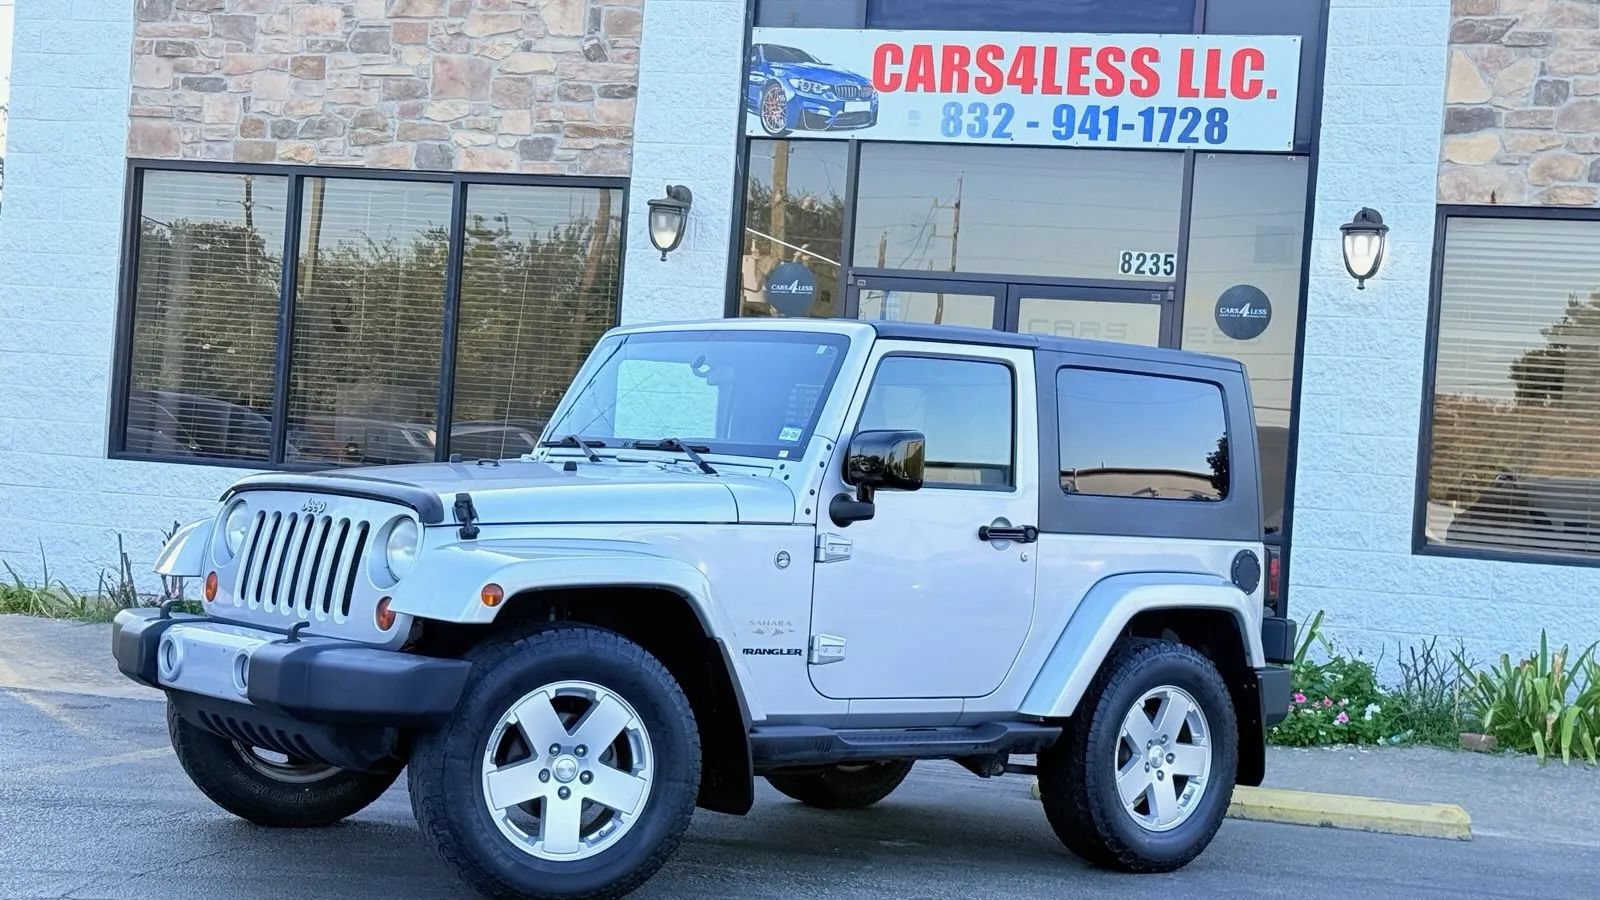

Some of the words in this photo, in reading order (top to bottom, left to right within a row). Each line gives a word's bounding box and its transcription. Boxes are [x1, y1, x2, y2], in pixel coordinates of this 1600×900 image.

[872, 43, 1161, 98] CARS4LESS
[1177, 47, 1278, 100] LLC.
[940, 101, 1015, 139] 832
[1052, 103, 1229, 145] 941-1728
[1120, 251, 1175, 276] 8235
[301, 497, 327, 516] Jeep
